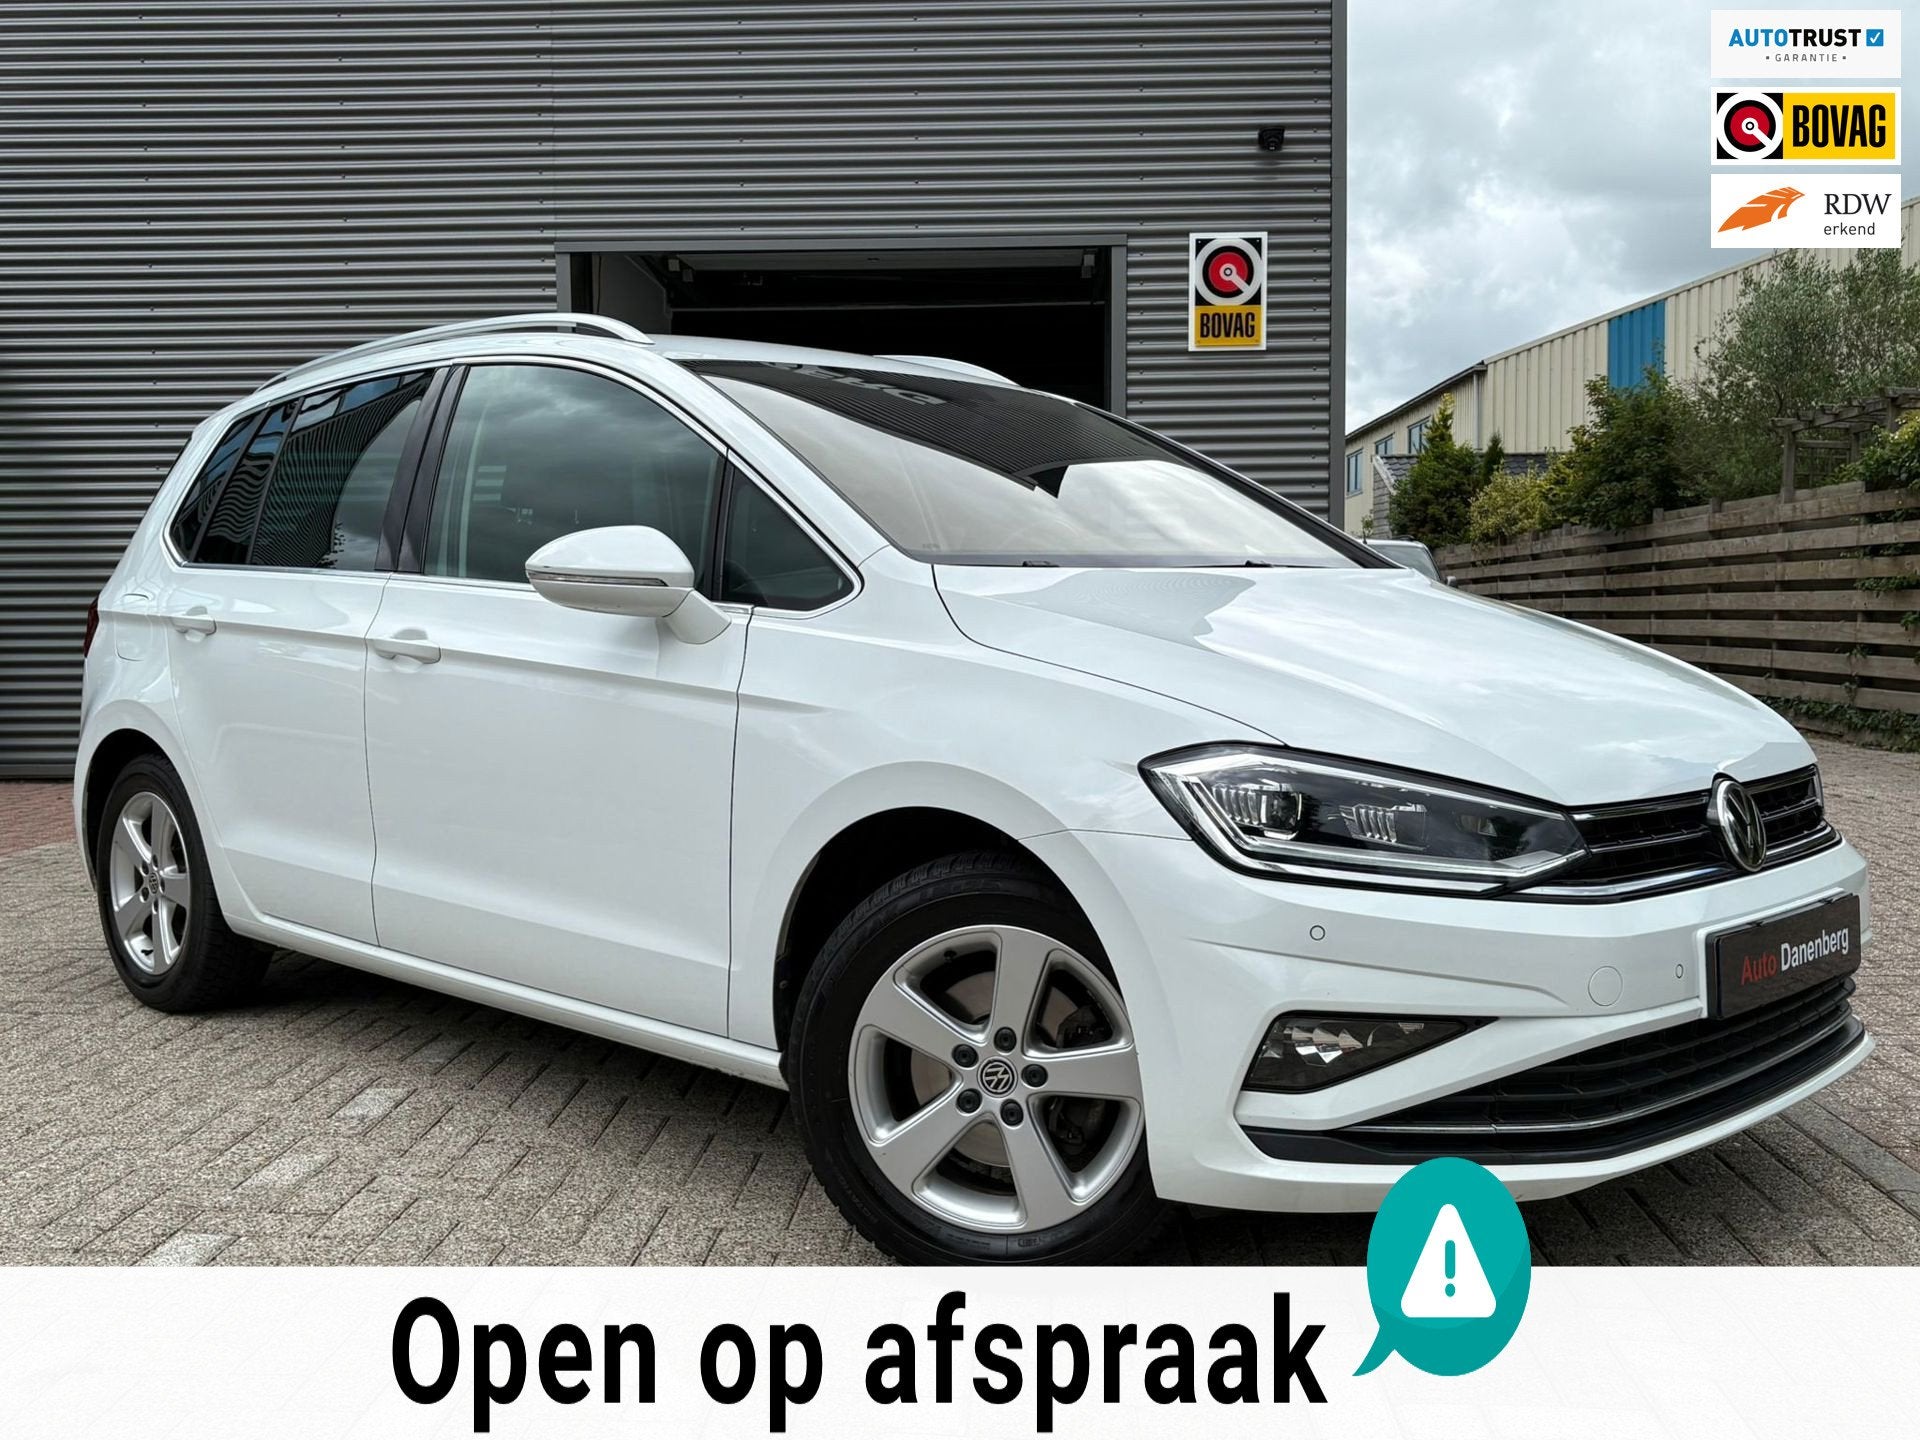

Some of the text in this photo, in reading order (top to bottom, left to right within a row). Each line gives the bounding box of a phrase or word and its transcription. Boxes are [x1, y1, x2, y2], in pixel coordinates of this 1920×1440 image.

[1200, 312, 1256, 339] BOVAG
[1740, 927, 1850, 986] Auto Danenberg
